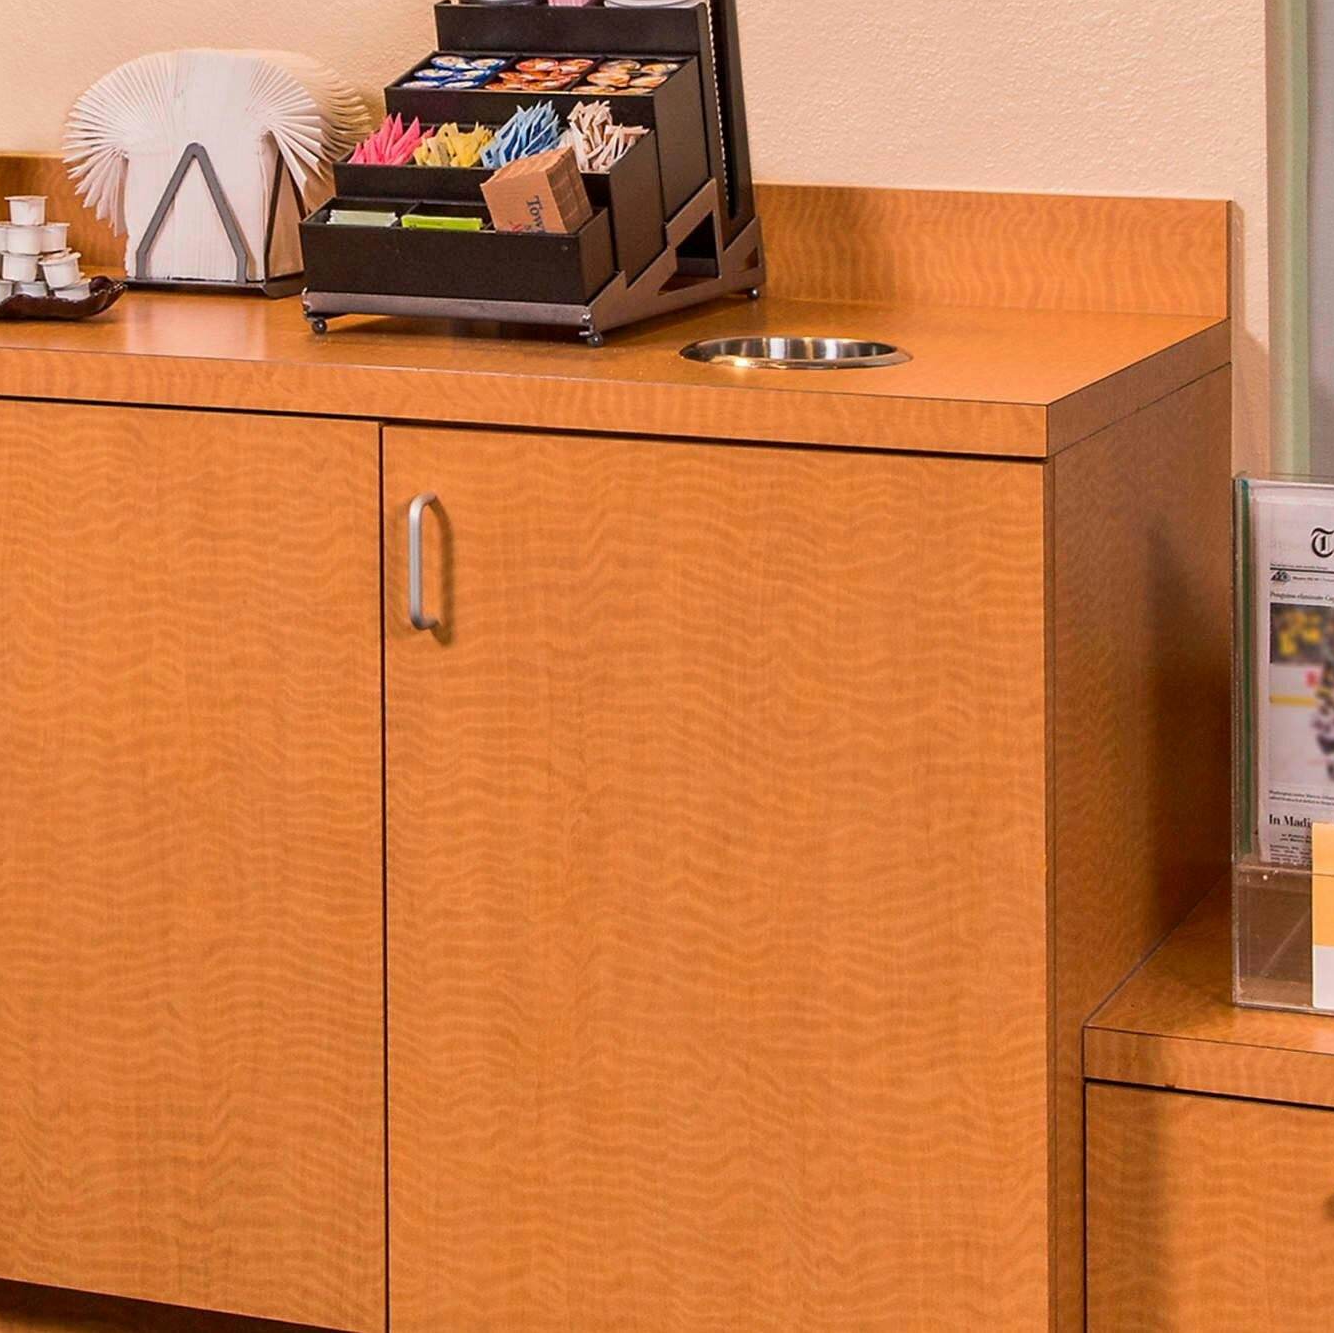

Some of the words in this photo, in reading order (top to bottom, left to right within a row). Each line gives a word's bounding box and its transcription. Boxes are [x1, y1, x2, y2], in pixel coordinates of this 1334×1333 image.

[527, 195, 545, 231] Tow
[1269, 813, 1281, 825] In
[1284, 815, 1312, 827] Madi
